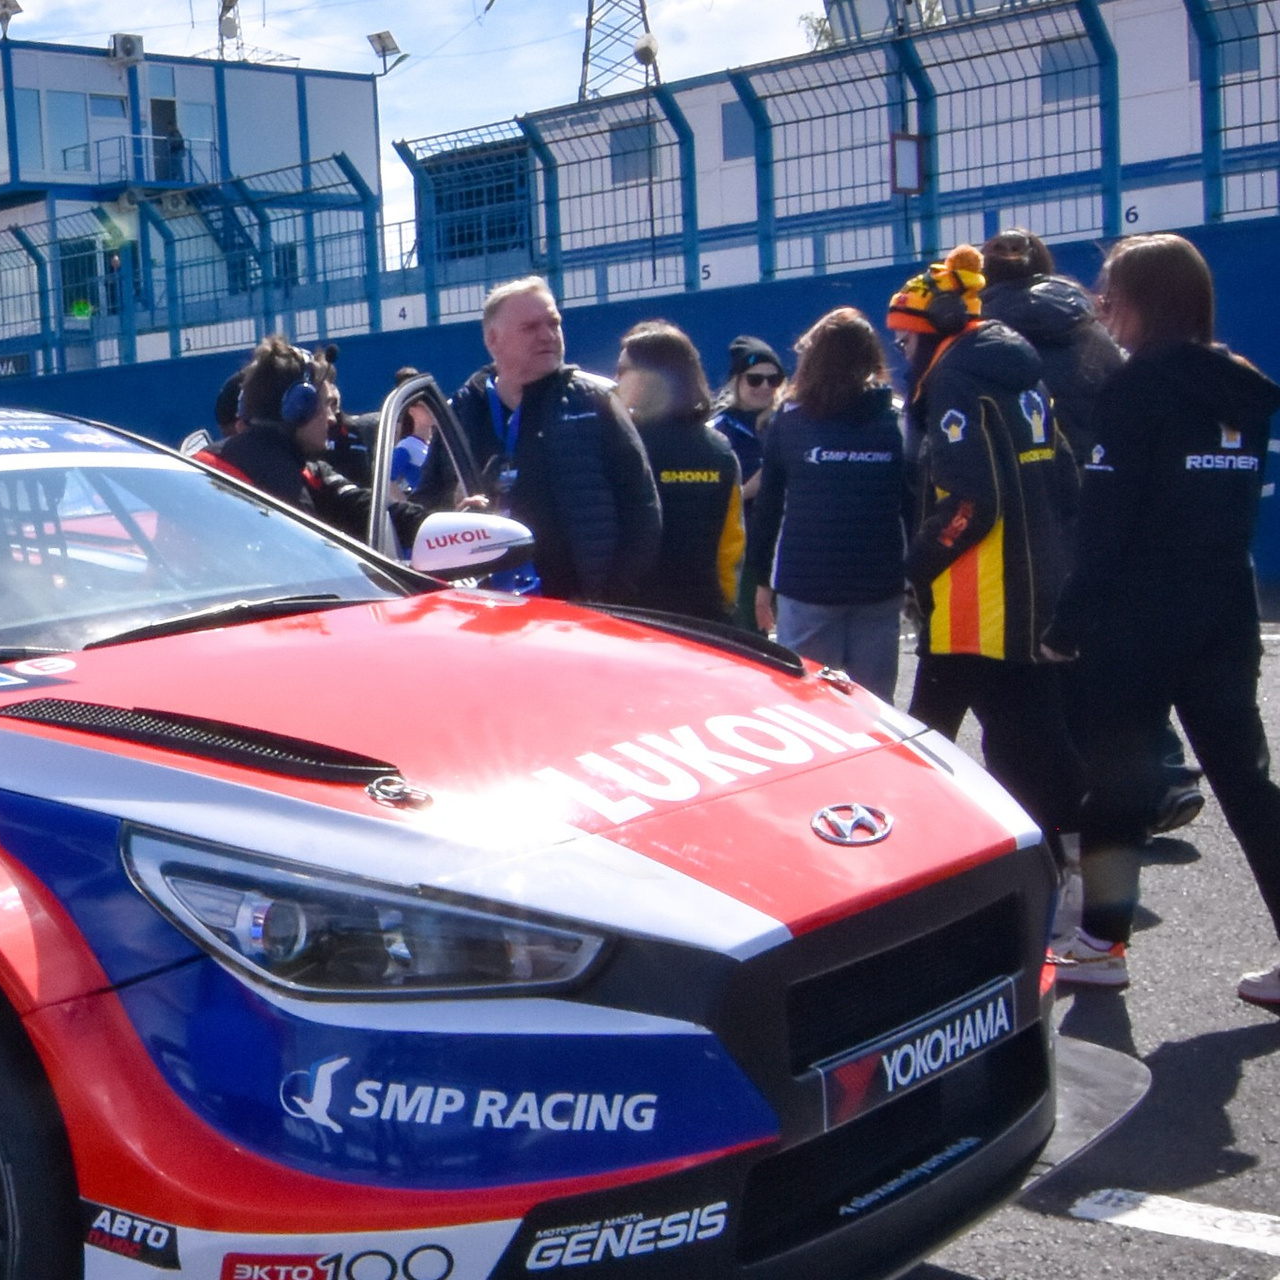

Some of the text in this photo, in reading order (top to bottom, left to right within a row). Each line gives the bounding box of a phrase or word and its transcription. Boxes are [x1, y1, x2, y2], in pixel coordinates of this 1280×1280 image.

[1125, 205, 1139, 224] 6
[701, 264, 712, 281] 5
[398, 306, 408, 321] 4
[820, 451, 893, 463] SMP RACING
[425, 528, 491, 550] LUKOIL
[532, 704, 884, 825] LUKOIL
[881, 996, 1010, 1093] YOKOHAMA
[350, 1079, 658, 1132] SMP RACING
[92, 1209, 170, 1250] АВТО
[525, 1200, 729, 1271] GENESIS
